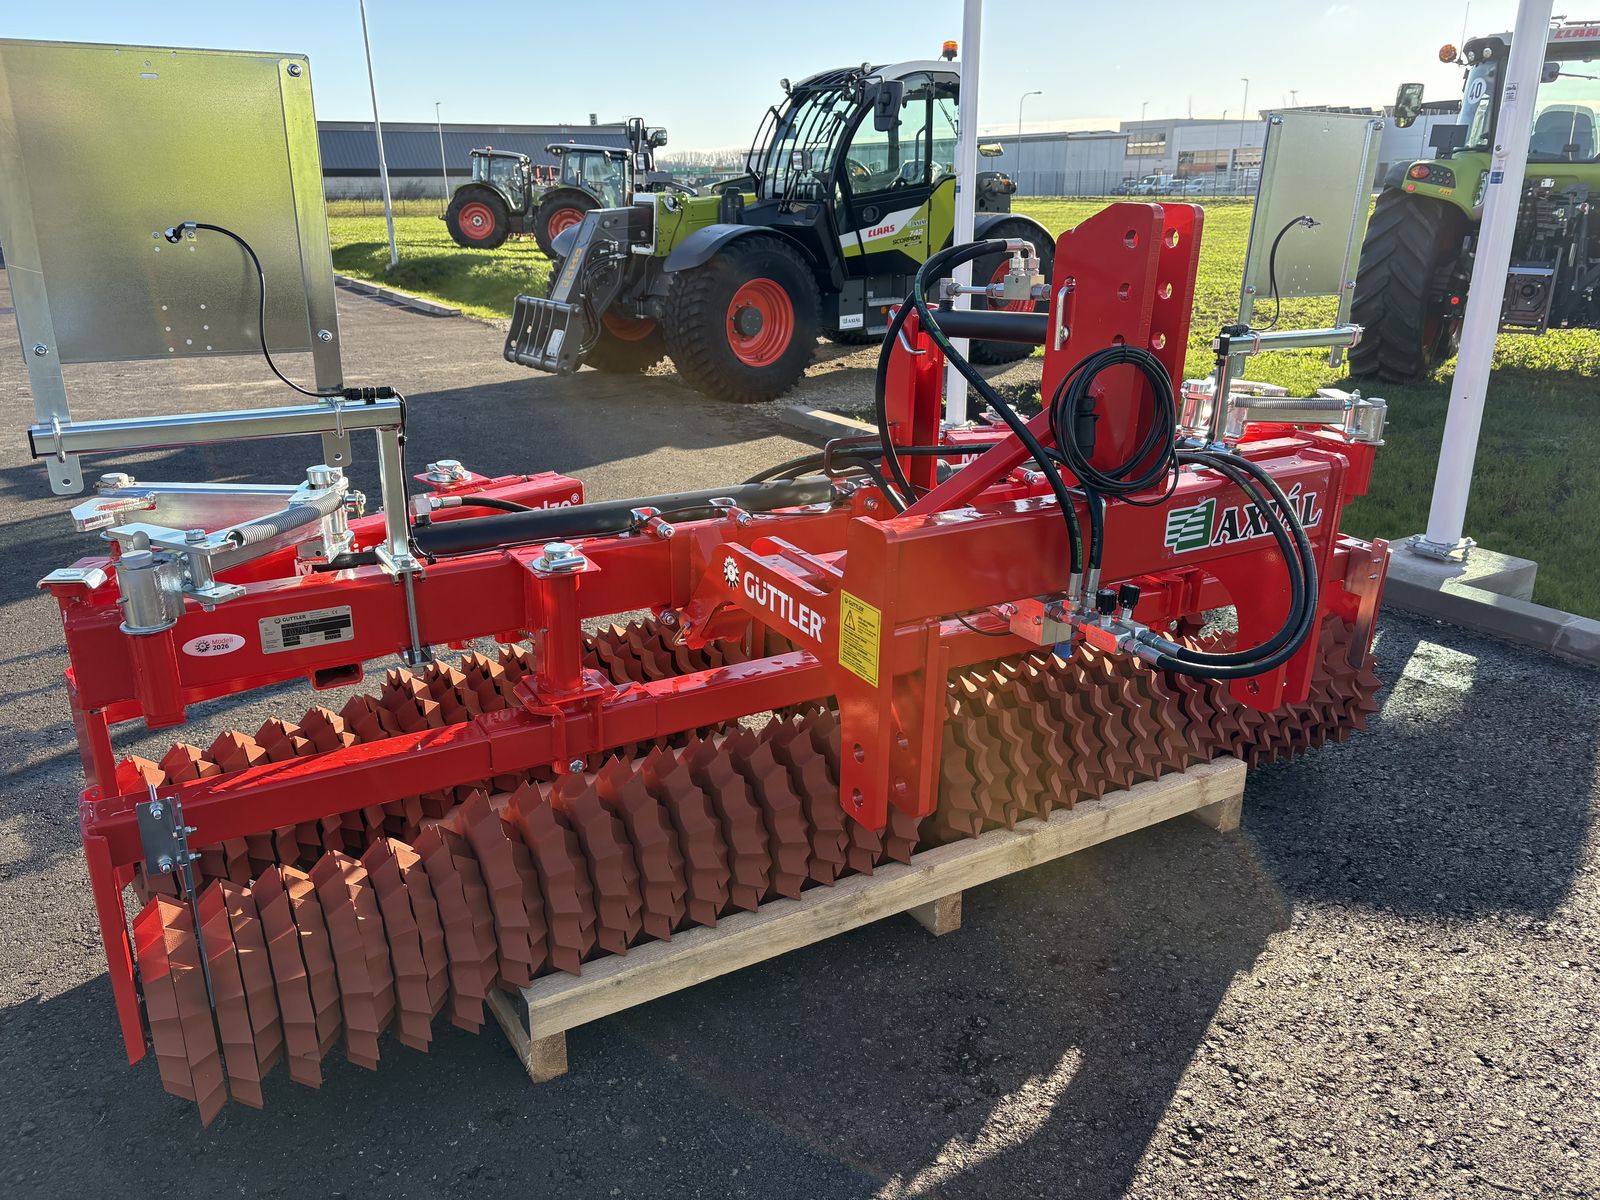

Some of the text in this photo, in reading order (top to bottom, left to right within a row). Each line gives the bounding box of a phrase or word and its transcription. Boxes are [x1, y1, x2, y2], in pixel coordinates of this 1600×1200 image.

[1554, 28, 1600, 38] CLAA
[1469, 82, 1482, 100] 40
[868, 224, 895, 238] CLAAS
[212, 643, 229, 651] 2026
